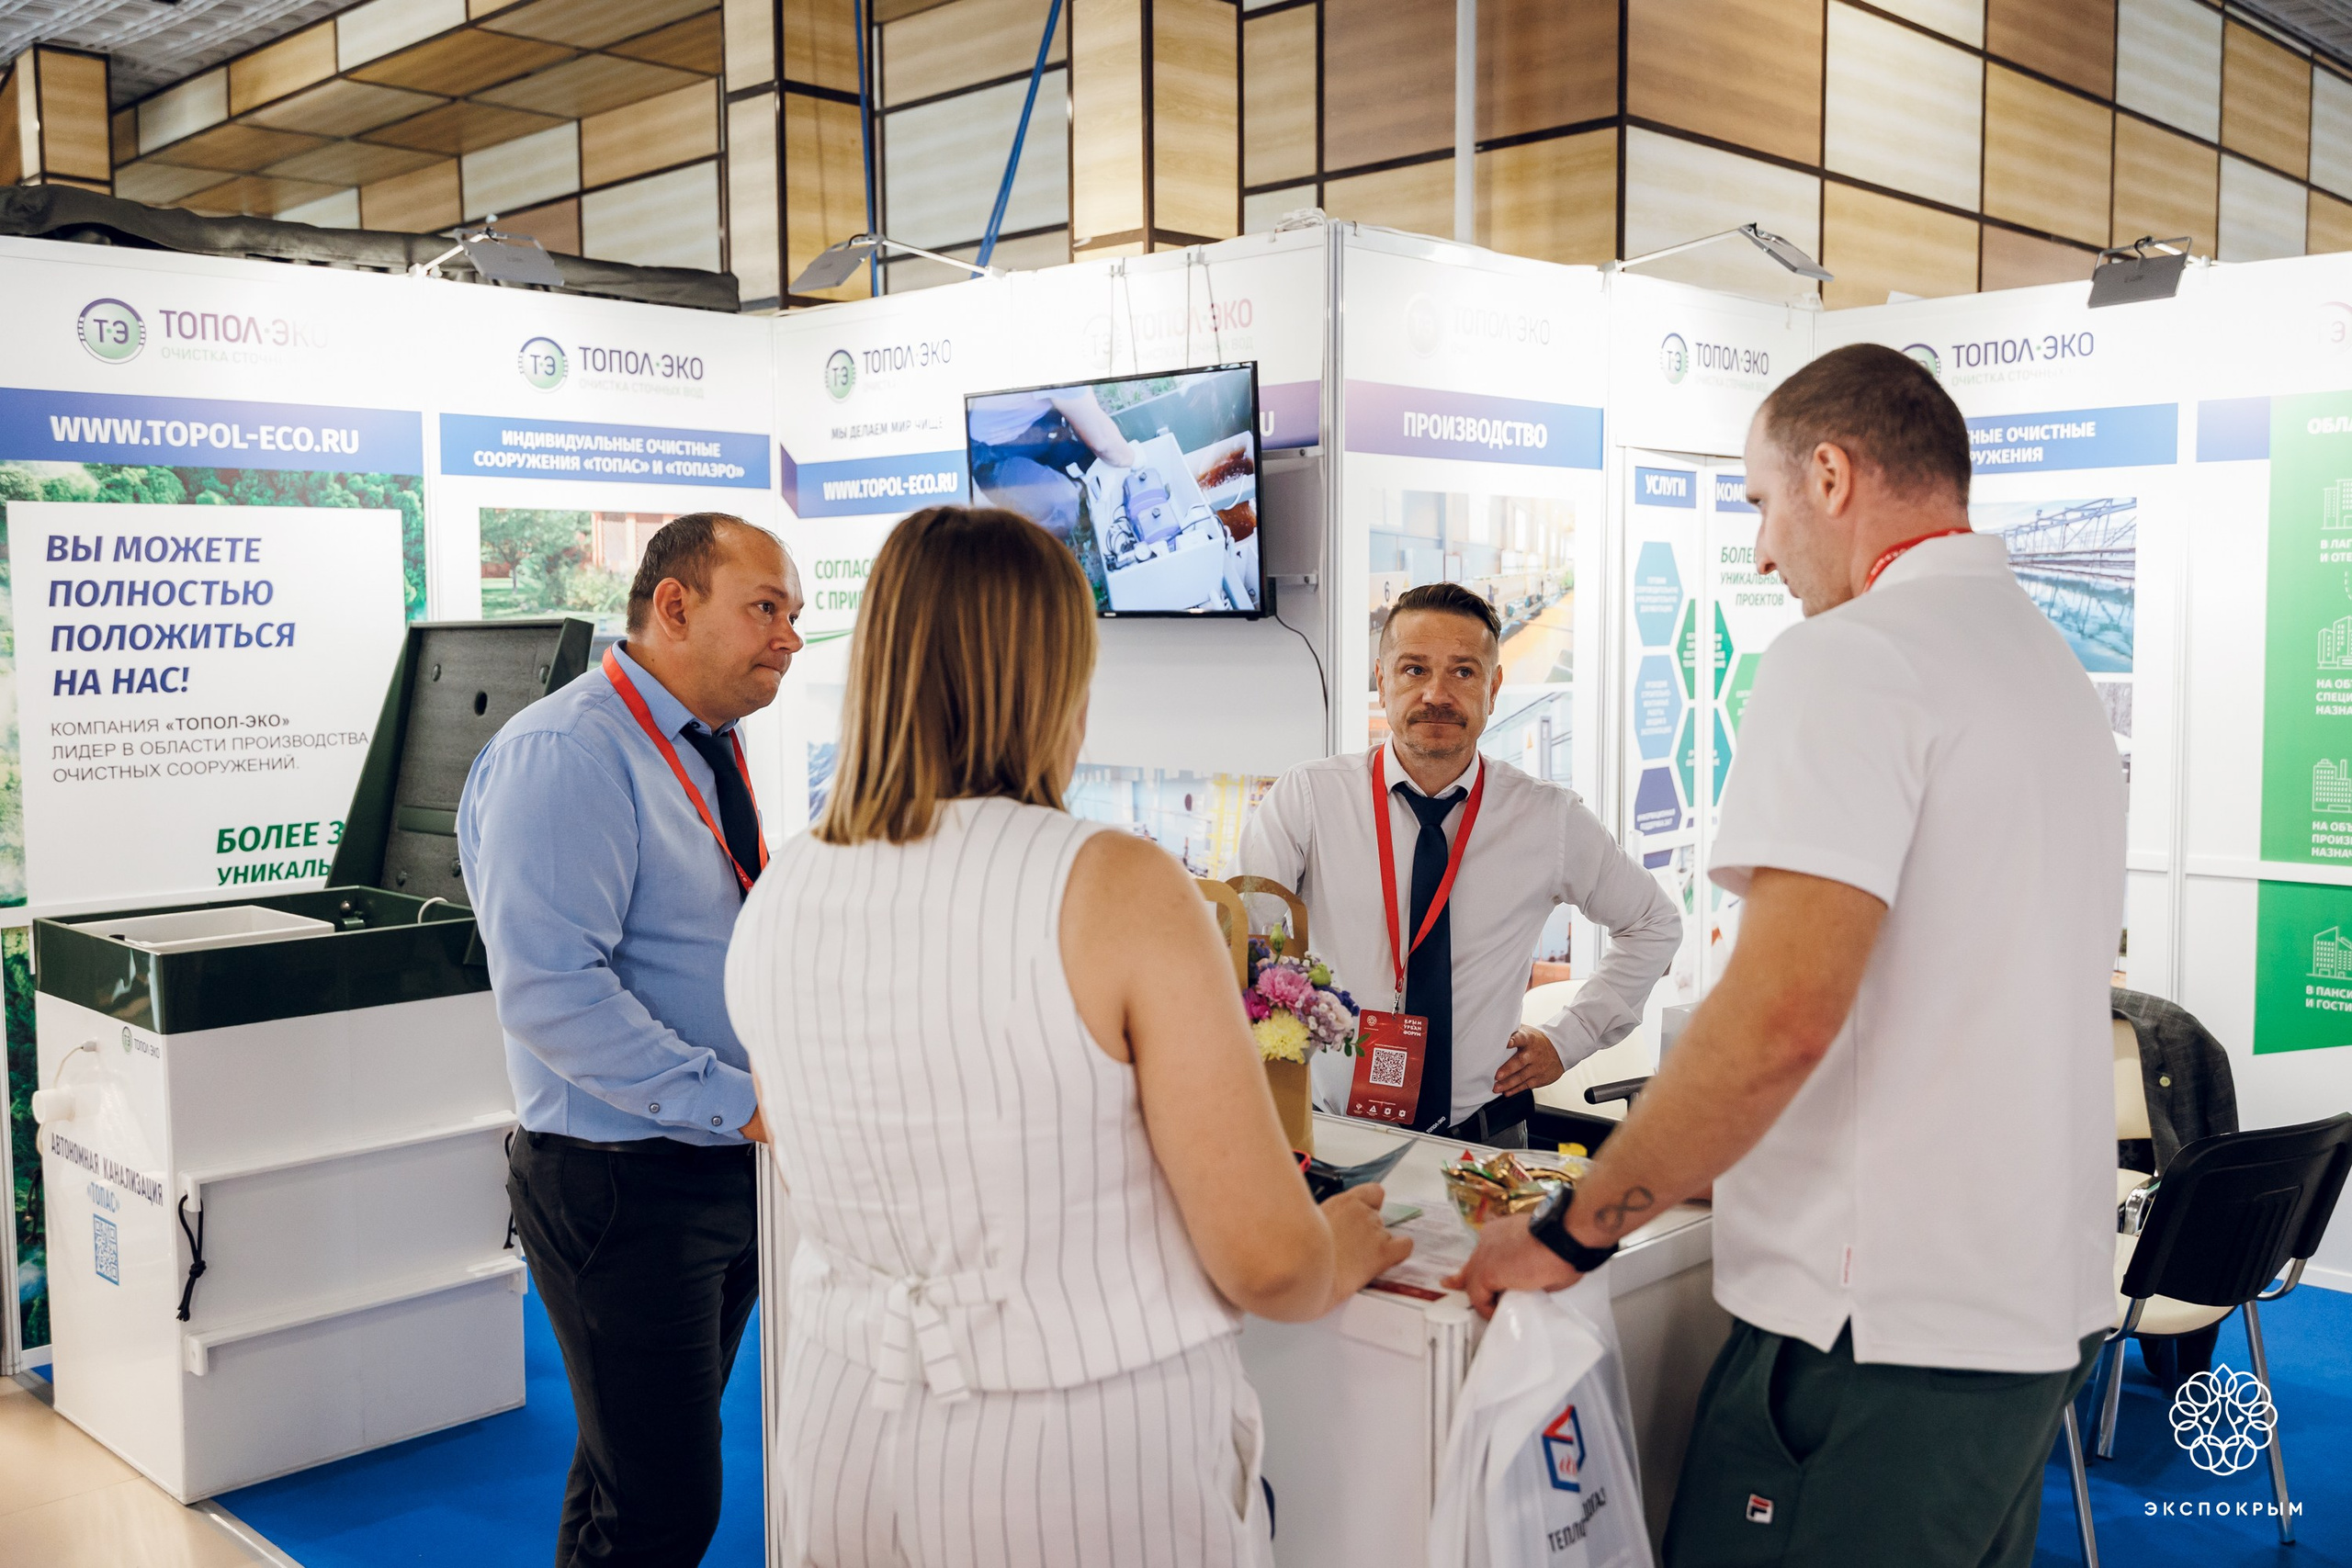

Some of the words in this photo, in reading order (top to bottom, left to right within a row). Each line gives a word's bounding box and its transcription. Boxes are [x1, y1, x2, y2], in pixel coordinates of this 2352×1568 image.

[162, 346, 228, 362] ОЧИСТКА
[579, 378, 629, 391] ОЧИСТКА
[631, 382, 681, 396] СТОЧНЫХ
[683, 386, 705, 399] ВОД
[1951, 372, 2005, 387] ОЧИСТКА
[50, 415, 359, 455] WWW.TOPOL-ECO.RU
[831, 426, 847, 441] МЫ
[849, 422, 888, 440] ДЕЛАЕМ
[890, 420, 911, 434] МИР
[1404, 411, 1548, 450] ПРОИЗВОДСТВО
[2007, 421, 2096, 442] ОЧИСТНЫЕ
[502, 430, 643, 454] ИНДИВИДУАЛЬНЫЕ
[646, 438, 721, 457] ОЧИСТНЫЕ
[473, 451, 581, 472] СООРУЖЕНИЯ
[582, 457, 650, 475] «ТОПАС»
[652, 462, 662, 475] И
[665, 462, 745, 479] «ТОПАЭРО»
[823, 472, 958, 502] WWW.TOPOL-ECO.RU
[1645, 474, 1687, 497] УСЛУГИ
[1716, 482, 1747, 502] КОМ
[46, 535, 103, 562] ВЫ
[113, 536, 262, 563] МОЖЕТЕ
[2320, 539, 2328, 549] В
[2320, 553, 2328, 562] И
[48, 580, 274, 607] ПОЛНОСТЬЮ
[816, 591, 824, 610] С
[1736, 593, 1784, 606] ПРОЕКТОВ
[51, 622, 296, 652] ПОЛОЖИТЬСЯ
[53, 669, 102, 696] НА
[112, 666, 190, 694] НАС!
[2316, 679, 2332, 689] НА
[51, 718, 159, 737] КОМПАНИЯ
[165, 713, 290, 732] «ТОПОЛ-ЭКО»
[51, 742, 116, 763] ЛИДЕР
[123, 743, 134, 756] В
[141, 739, 226, 756] ОБЛАСТИ
[232, 731, 368, 751] ПРОИЗВОДСТВА
[53, 765, 161, 784] ОЧИСТНЫХ
[167, 754, 300, 777] СООРУЖЕНИЙ.
[2312, 820, 2328, 831] НА
[217, 821, 320, 854] БОЛЕЕ
[2305, 985, 2313, 995] В
[2305, 998, 2313, 1008] И
[51, 1132, 99, 1175] АВТОНОМНАЯ
[103, 1156, 164, 1206] КАНАЛИЗАЦИЯ
[87, 1181, 120, 1213] «ТОПАС»
